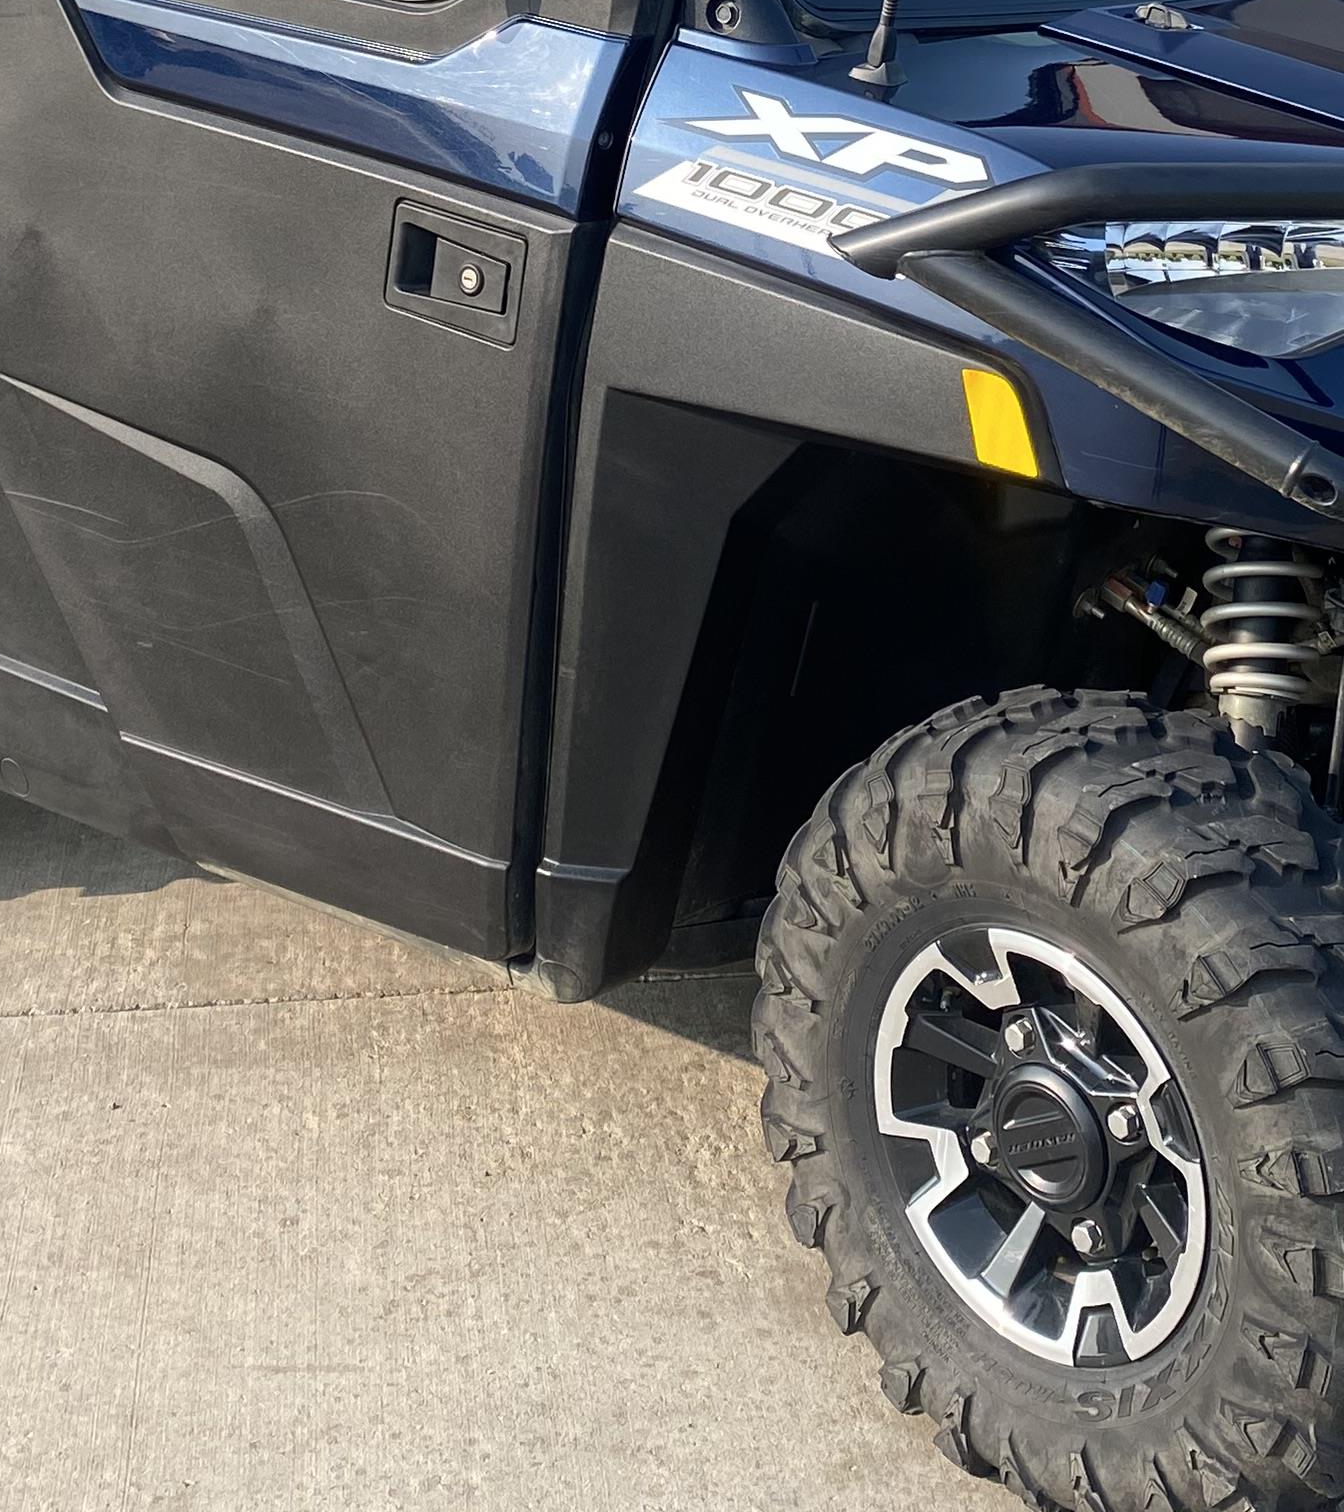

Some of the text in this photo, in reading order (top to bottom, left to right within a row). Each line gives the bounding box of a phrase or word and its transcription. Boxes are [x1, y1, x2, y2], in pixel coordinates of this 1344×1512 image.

[659, 85, 994, 189] XP
[690, 190, 832, 237] DUAL OVERHEA
